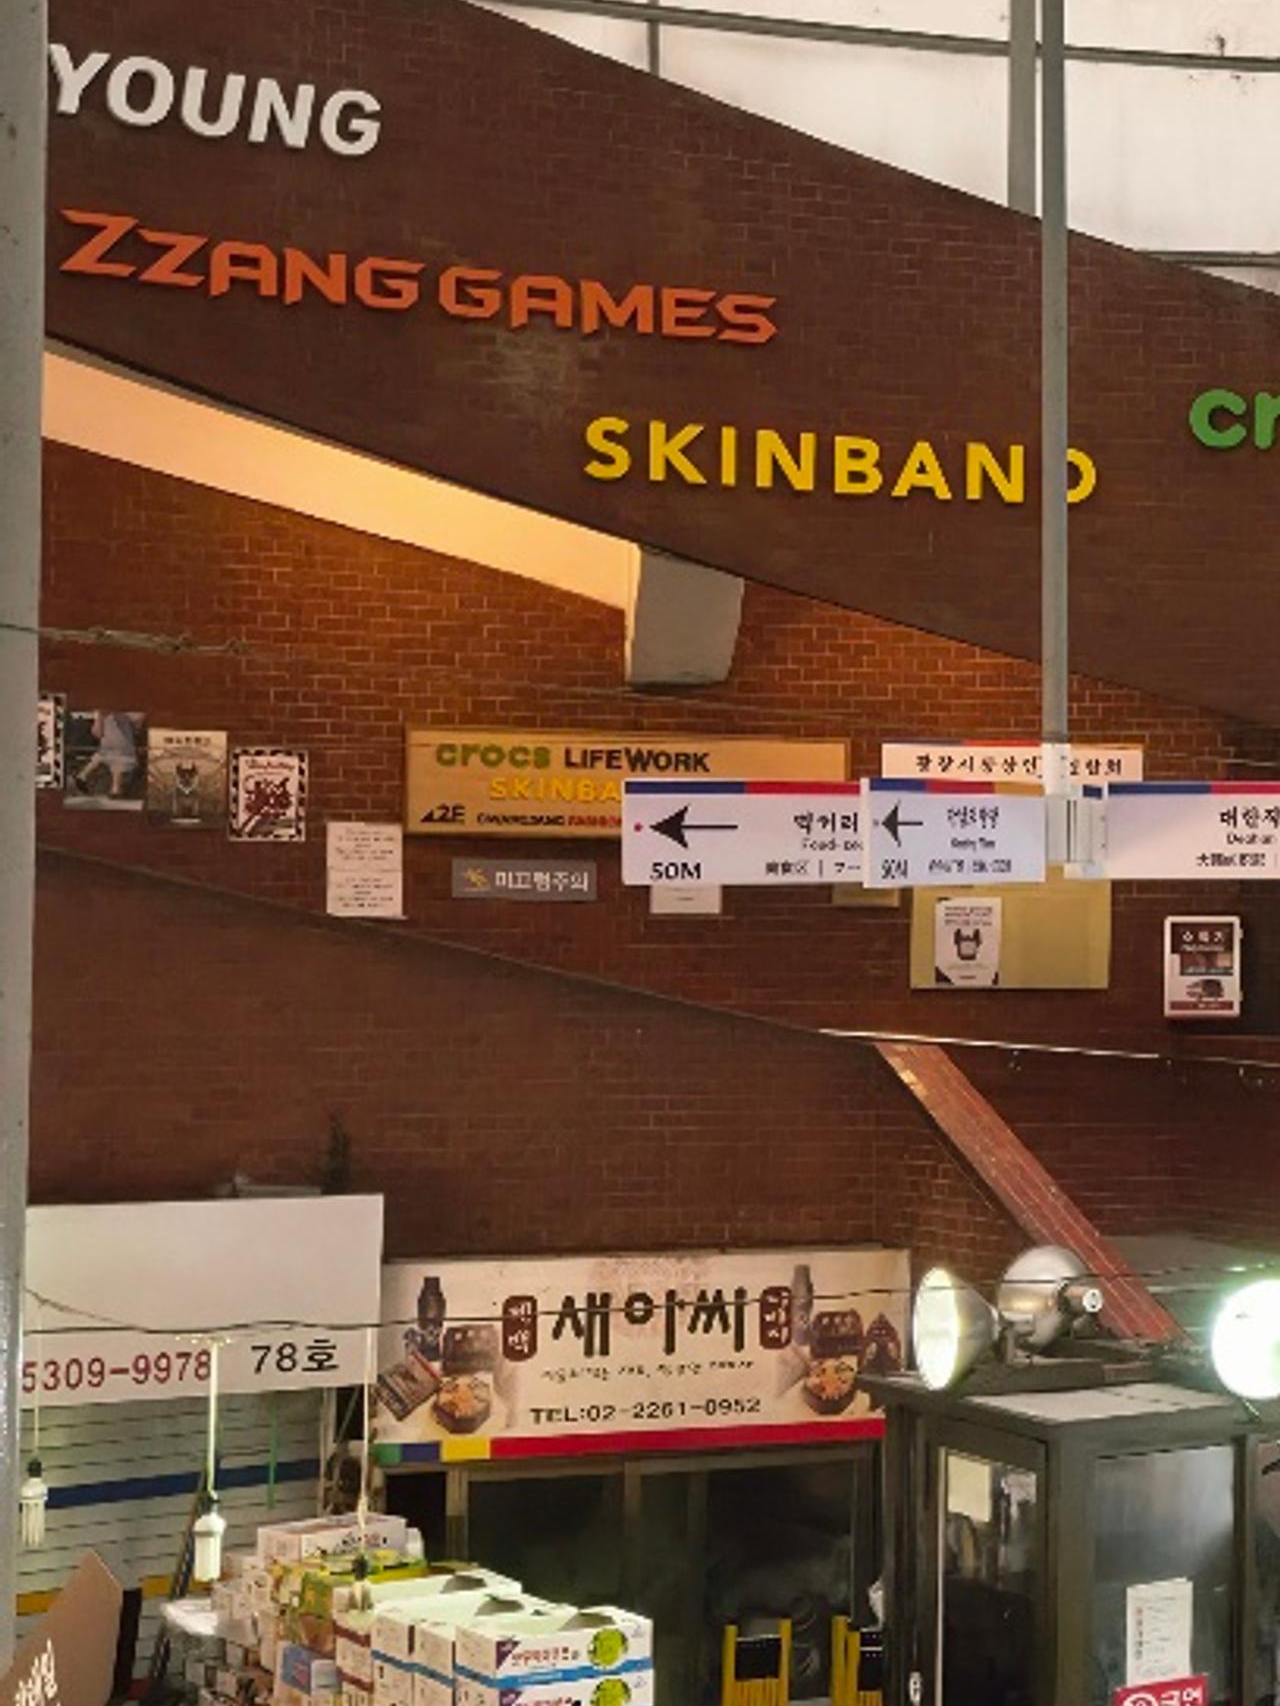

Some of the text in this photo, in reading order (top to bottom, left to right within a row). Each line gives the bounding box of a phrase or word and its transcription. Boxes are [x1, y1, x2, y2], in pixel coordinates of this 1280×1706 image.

[49, 43, 383, 156] YOUNG
[60, 209, 778, 344] ZZANG GAMES
[584, 416, 1097, 504] SKINBAND
[435, 744, 711, 772] crocs LIFEWORK
[650, 861, 701, 881] 50M
[552, 1287, 747, 1358] 새아씨
[251, 1340, 339, 1377] 78호
